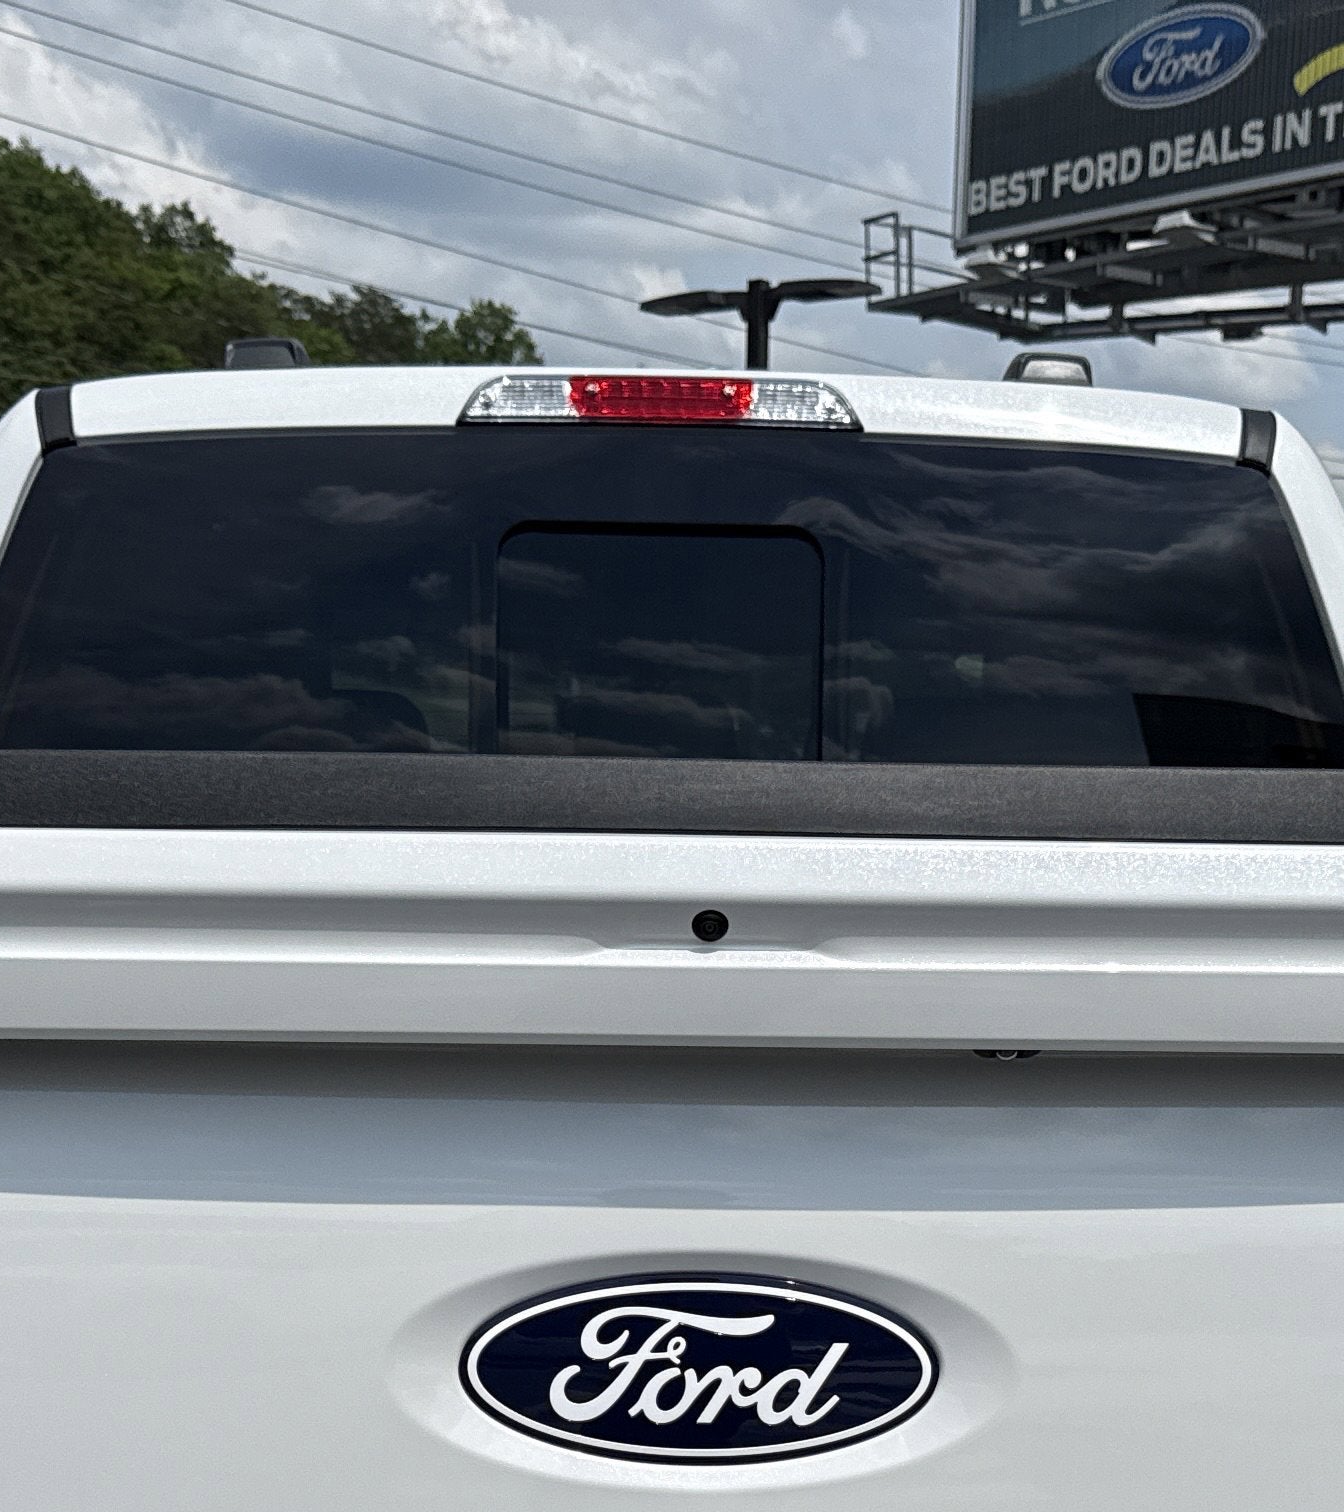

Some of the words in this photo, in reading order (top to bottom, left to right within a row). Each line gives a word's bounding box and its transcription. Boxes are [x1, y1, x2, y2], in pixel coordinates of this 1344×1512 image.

[1132, 26, 1224, 92] Ford
[969, 165, 1049, 217] BEST
[1051, 147, 1144, 199] FORD
[1147, 117, 1265, 179] DEALS
[1271, 106, 1313, 153] IN
[548, 1304, 840, 1427] Ford
